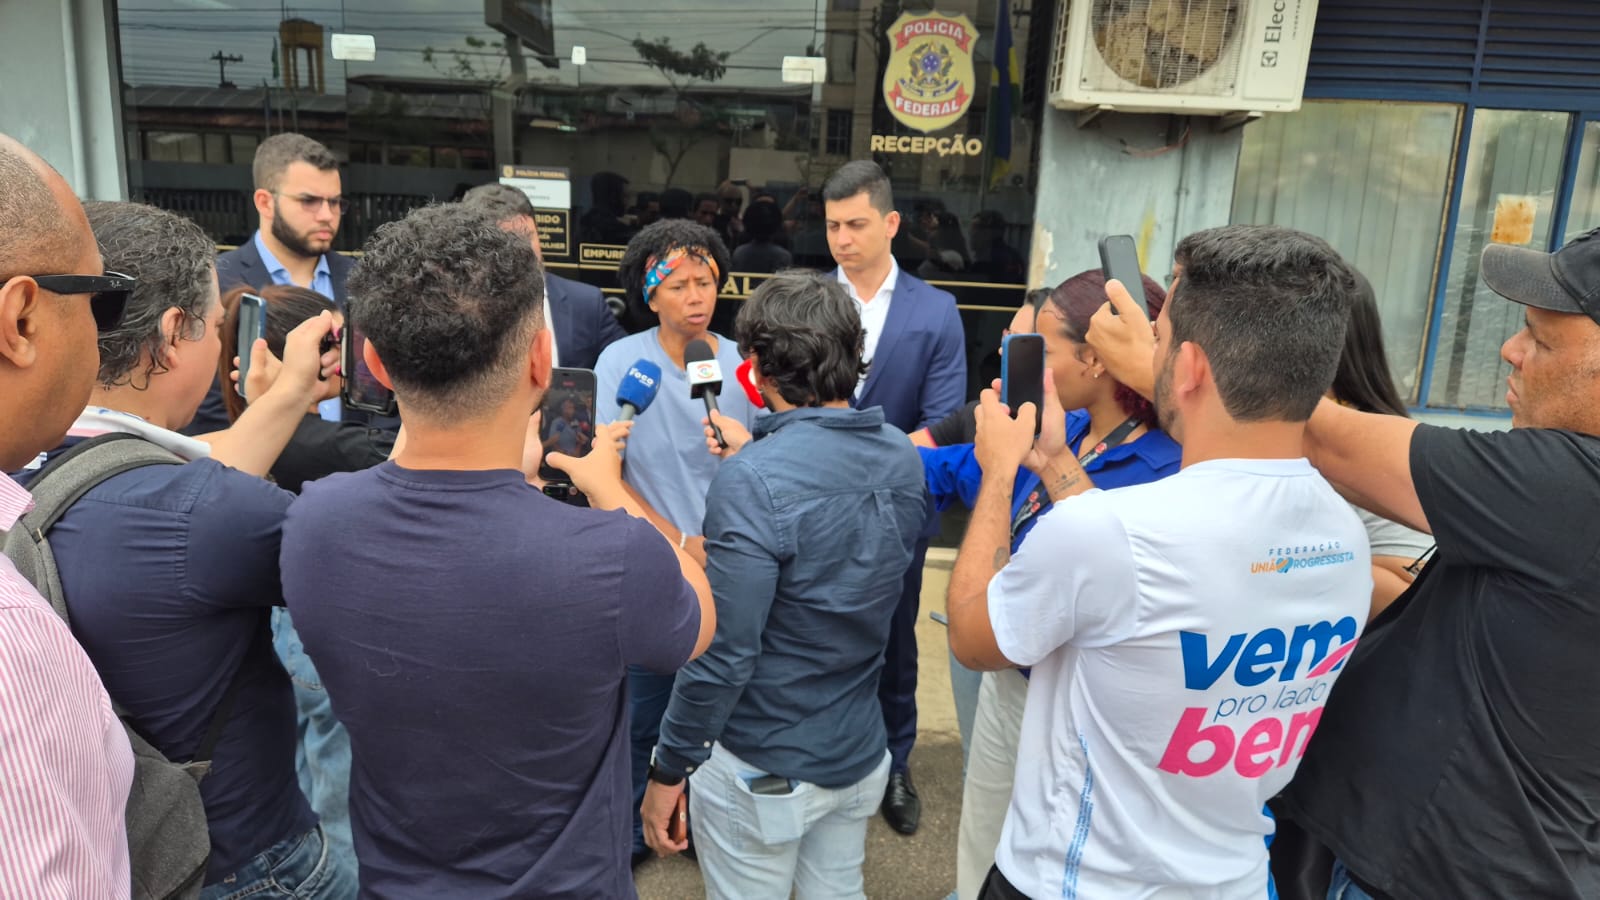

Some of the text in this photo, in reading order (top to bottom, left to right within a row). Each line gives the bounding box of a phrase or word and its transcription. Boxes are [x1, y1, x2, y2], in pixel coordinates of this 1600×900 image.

[904, 21, 963, 40] POLÍCIA
[895, 96, 960, 117] FEDERAL
[870, 134, 983, 157] RECEPÇÃO
[1269, 541, 1341, 556] FEDERAÇÃO
[1179, 616, 1357, 690] vem
[1213, 680, 1327, 722] pro lado
